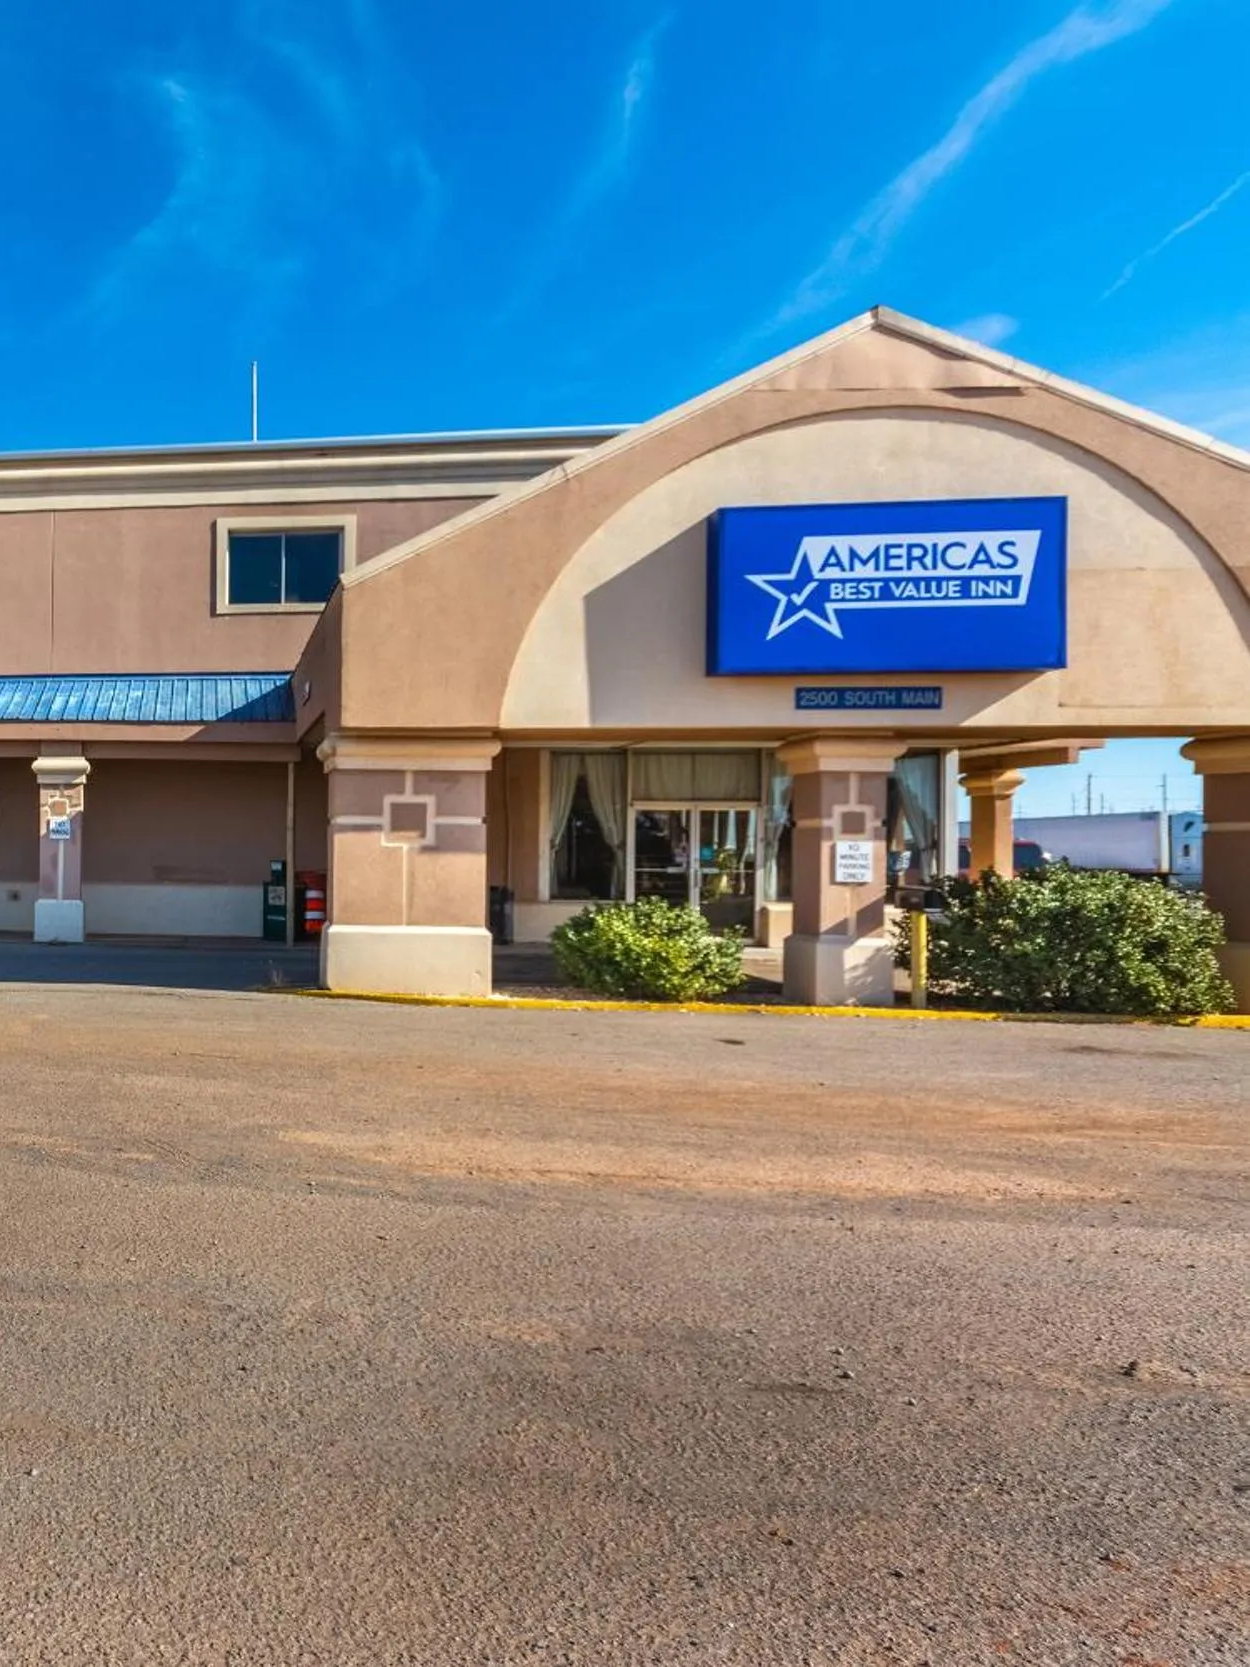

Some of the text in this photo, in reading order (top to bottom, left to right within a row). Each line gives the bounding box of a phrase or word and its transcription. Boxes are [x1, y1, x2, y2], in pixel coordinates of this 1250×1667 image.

[818, 540, 1020, 573] AMERICAS
[829, 579, 1013, 600] BEST VALUE INN
[800, 690, 940, 705] 2500 SOUTH MAIN
